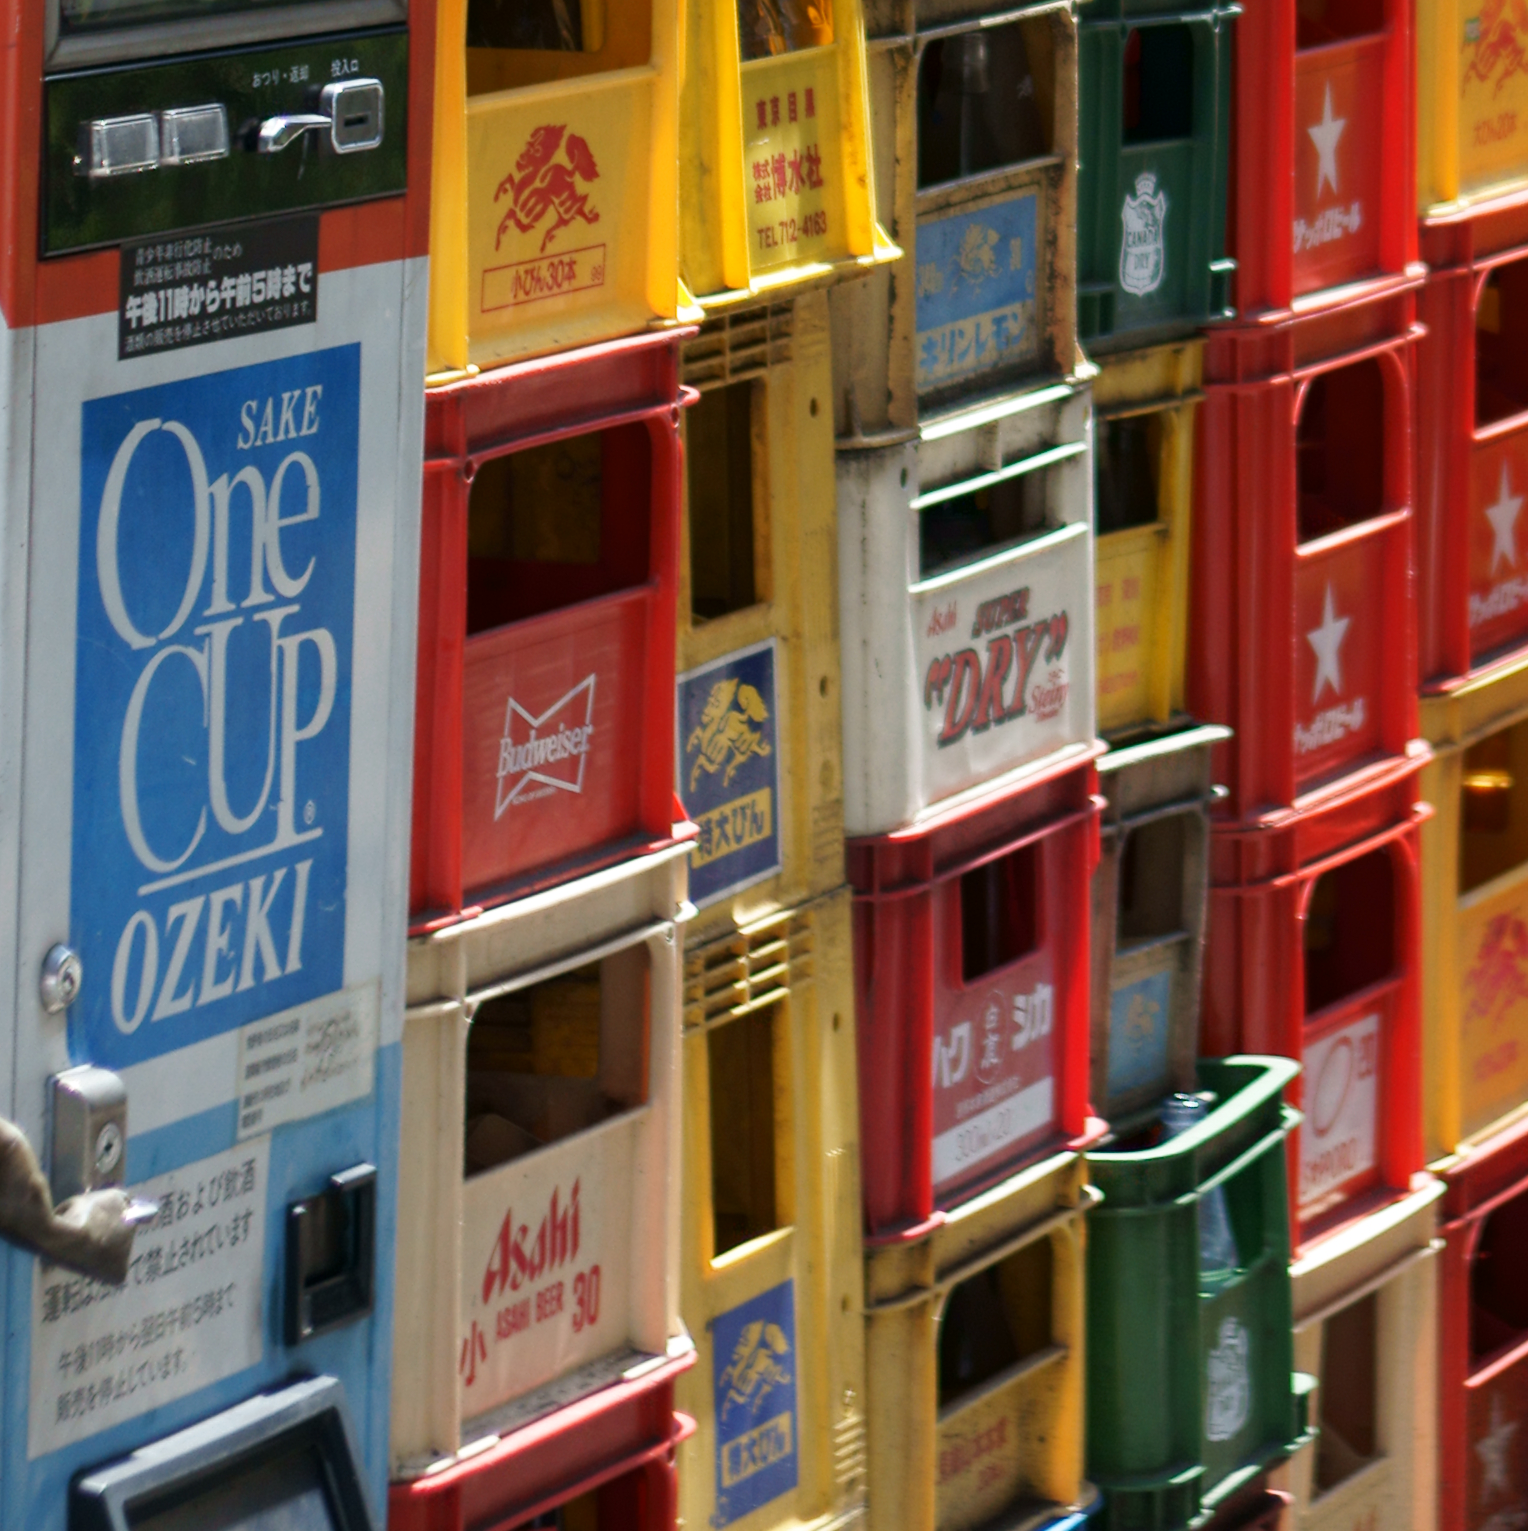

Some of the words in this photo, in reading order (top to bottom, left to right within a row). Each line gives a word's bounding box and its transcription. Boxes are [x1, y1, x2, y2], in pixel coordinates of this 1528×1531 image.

[331, 58, 359, 77] 投入口
[757, 225, 778, 250] TEL
[779, 210, 828, 244] 712-4163
[125, 262, 313, 330] 午後11時から午前5時まで
[919, 312, 1026, 374] キリンレモン
[237, 384, 323, 450] SAKE
[97, 418, 321, 650] One
[971, 586, 1030, 639] SUPER
[119, 605, 338, 872] CUP
[496, 722, 594, 778] Budweiser
[110, 858, 313, 1035] OZEKI
[481, 1176, 581, 1304] Asahi
[460, 1319, 488, 1386] 小
[495, 1291, 531, 1344] ASAHI
[536, 1280, 563, 1324] BEER
[573, 1263, 600, 1333] 30
